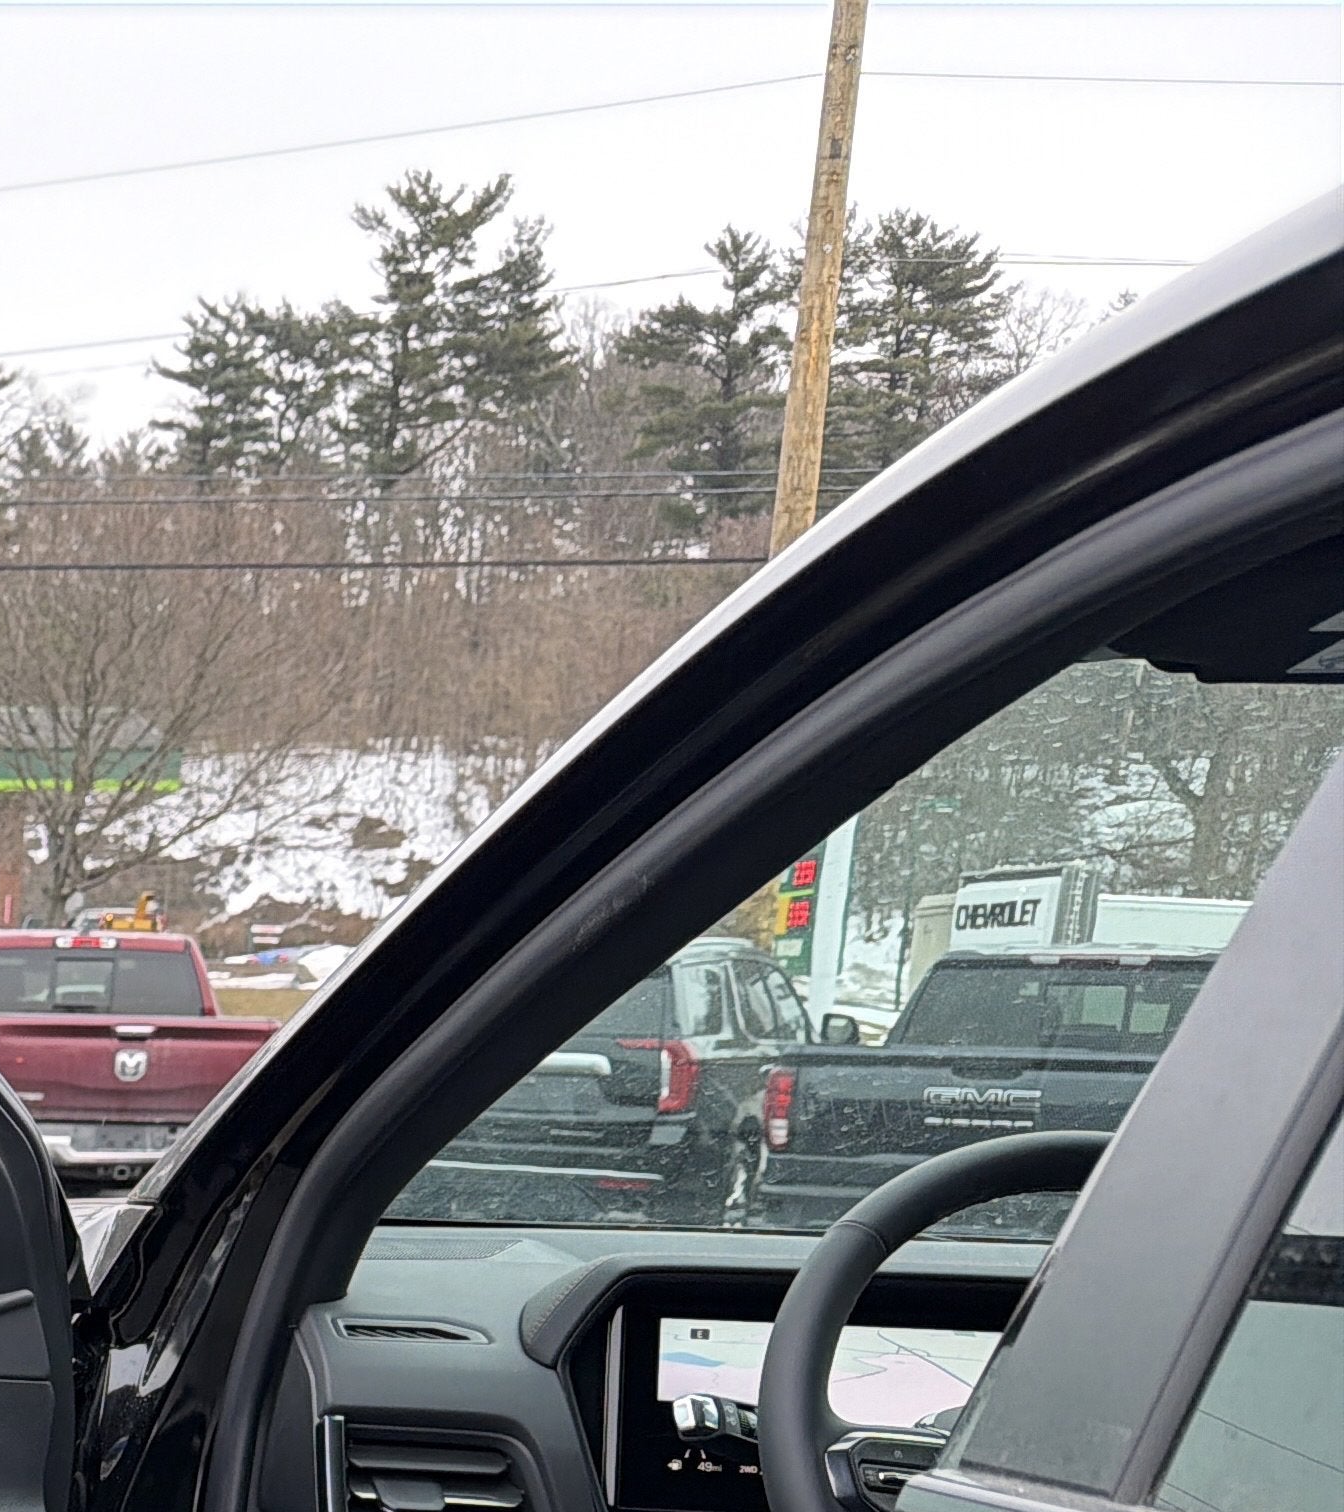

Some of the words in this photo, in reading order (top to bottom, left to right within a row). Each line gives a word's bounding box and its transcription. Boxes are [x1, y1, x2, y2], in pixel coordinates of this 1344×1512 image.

[955, 898, 1042, 931] CHEVROLET
[923, 1086, 1042, 1113] GMC
[739, 1465, 758, 1474] 2WD
